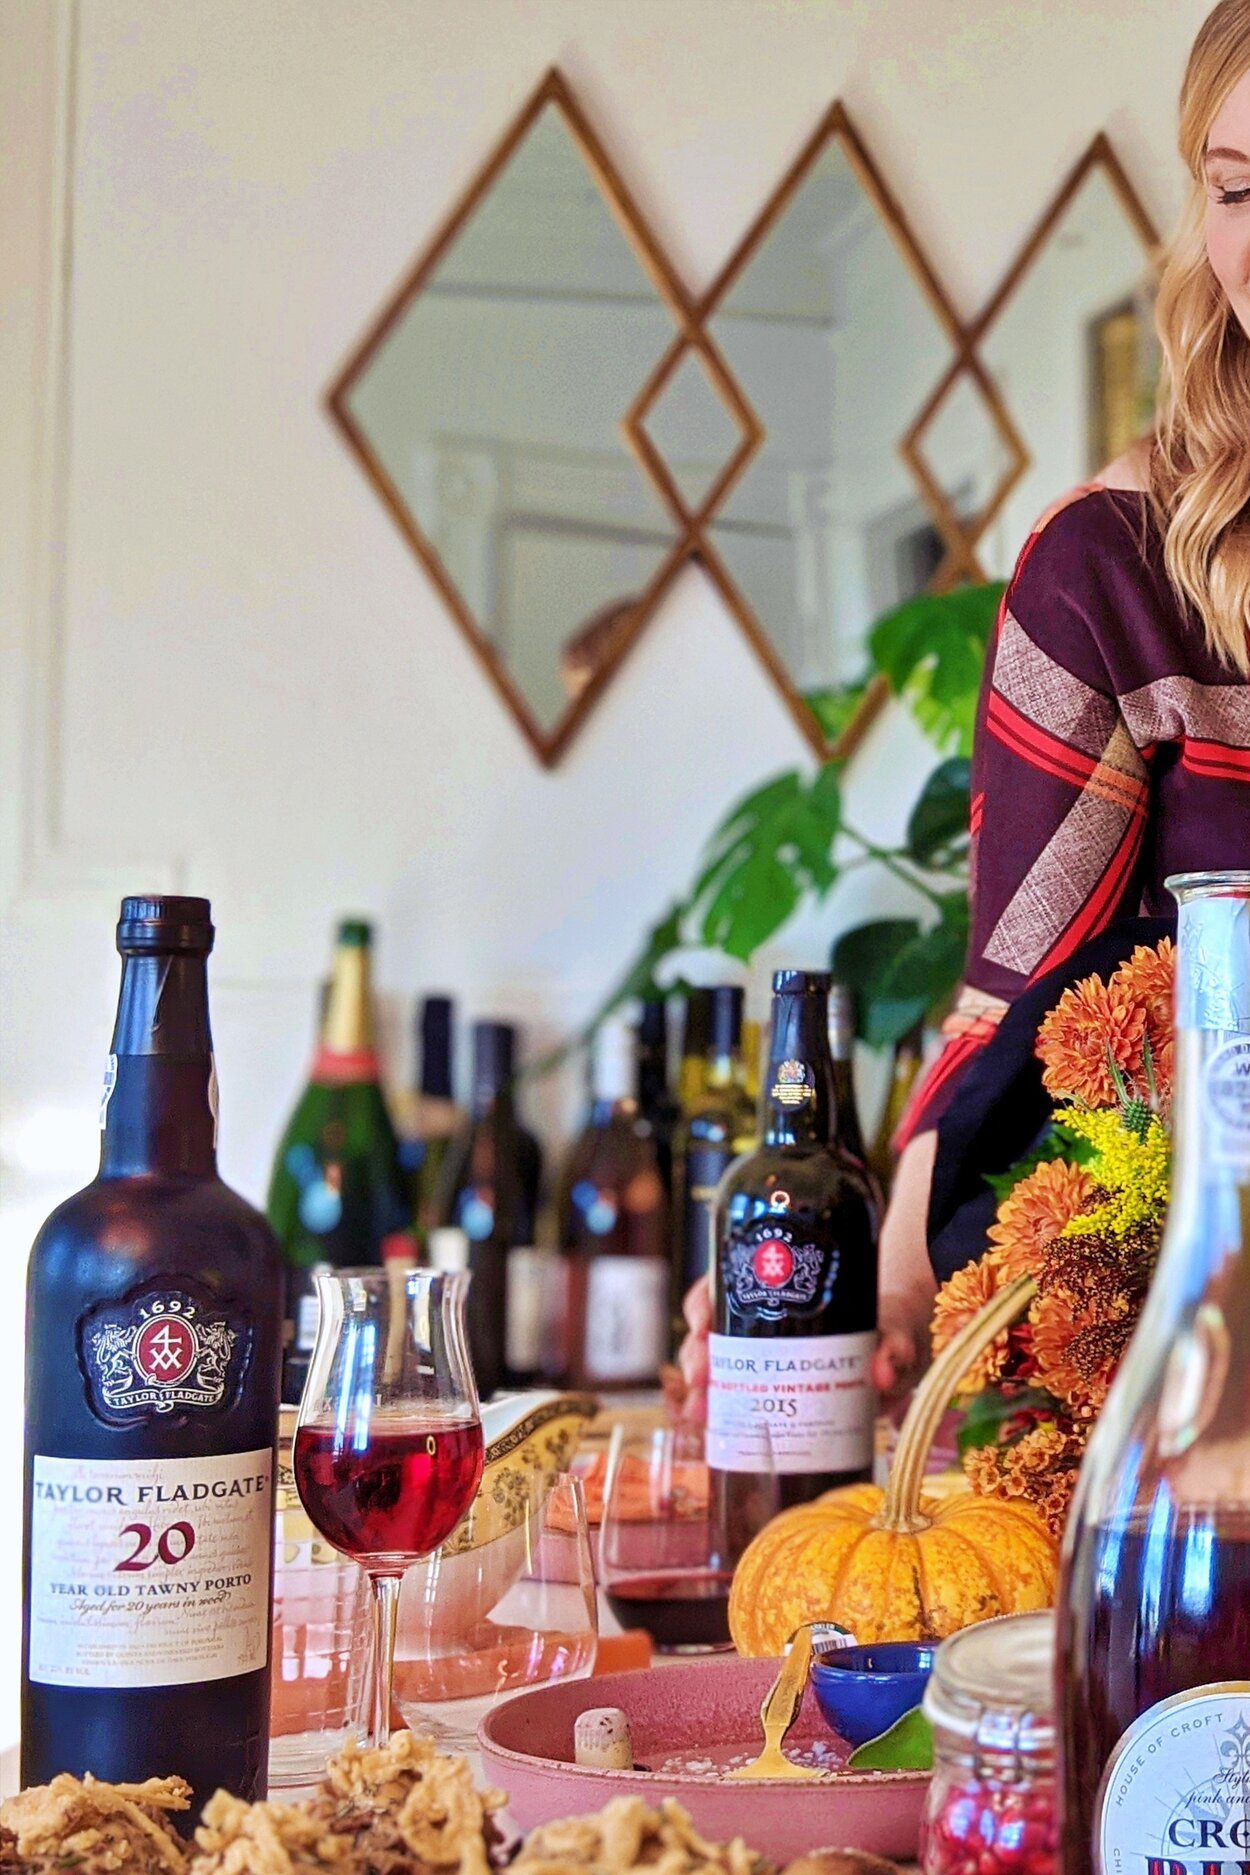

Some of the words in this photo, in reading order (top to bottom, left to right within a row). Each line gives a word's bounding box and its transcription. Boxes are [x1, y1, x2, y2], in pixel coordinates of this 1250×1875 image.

[139, 1300, 196, 1319] 1692
[764, 1357, 857, 1371] FLADGATE
[114, 1391, 158, 1406] TAYLOR
[165, 1391, 214, 1402] FLADGATE
[751, 1398, 798, 1417] 2015
[35, 1481, 127, 1506] TAYLOR
[138, 1474, 266, 1503] FLADGATE
[113, 1521, 196, 1572] 20
[49, 1582, 89, 1596] YEAR
[94, 1584, 131, 1597] OLD
[138, 1581, 202, 1596] TAWNY
[205, 1574, 252, 1592] PORTO
[69, 1599, 104, 1616] Aged
[103, 1600, 127, 1617] for
[127, 1601, 144, 1612] 20
[144, 1599, 181, 1616] years
[1116, 1756, 1145, 1807] HOUSE
[1147, 1736, 1164, 1754] OF
[1170, 1713, 1223, 1737] CROFT
[1184, 1788, 1222, 1809] pink
